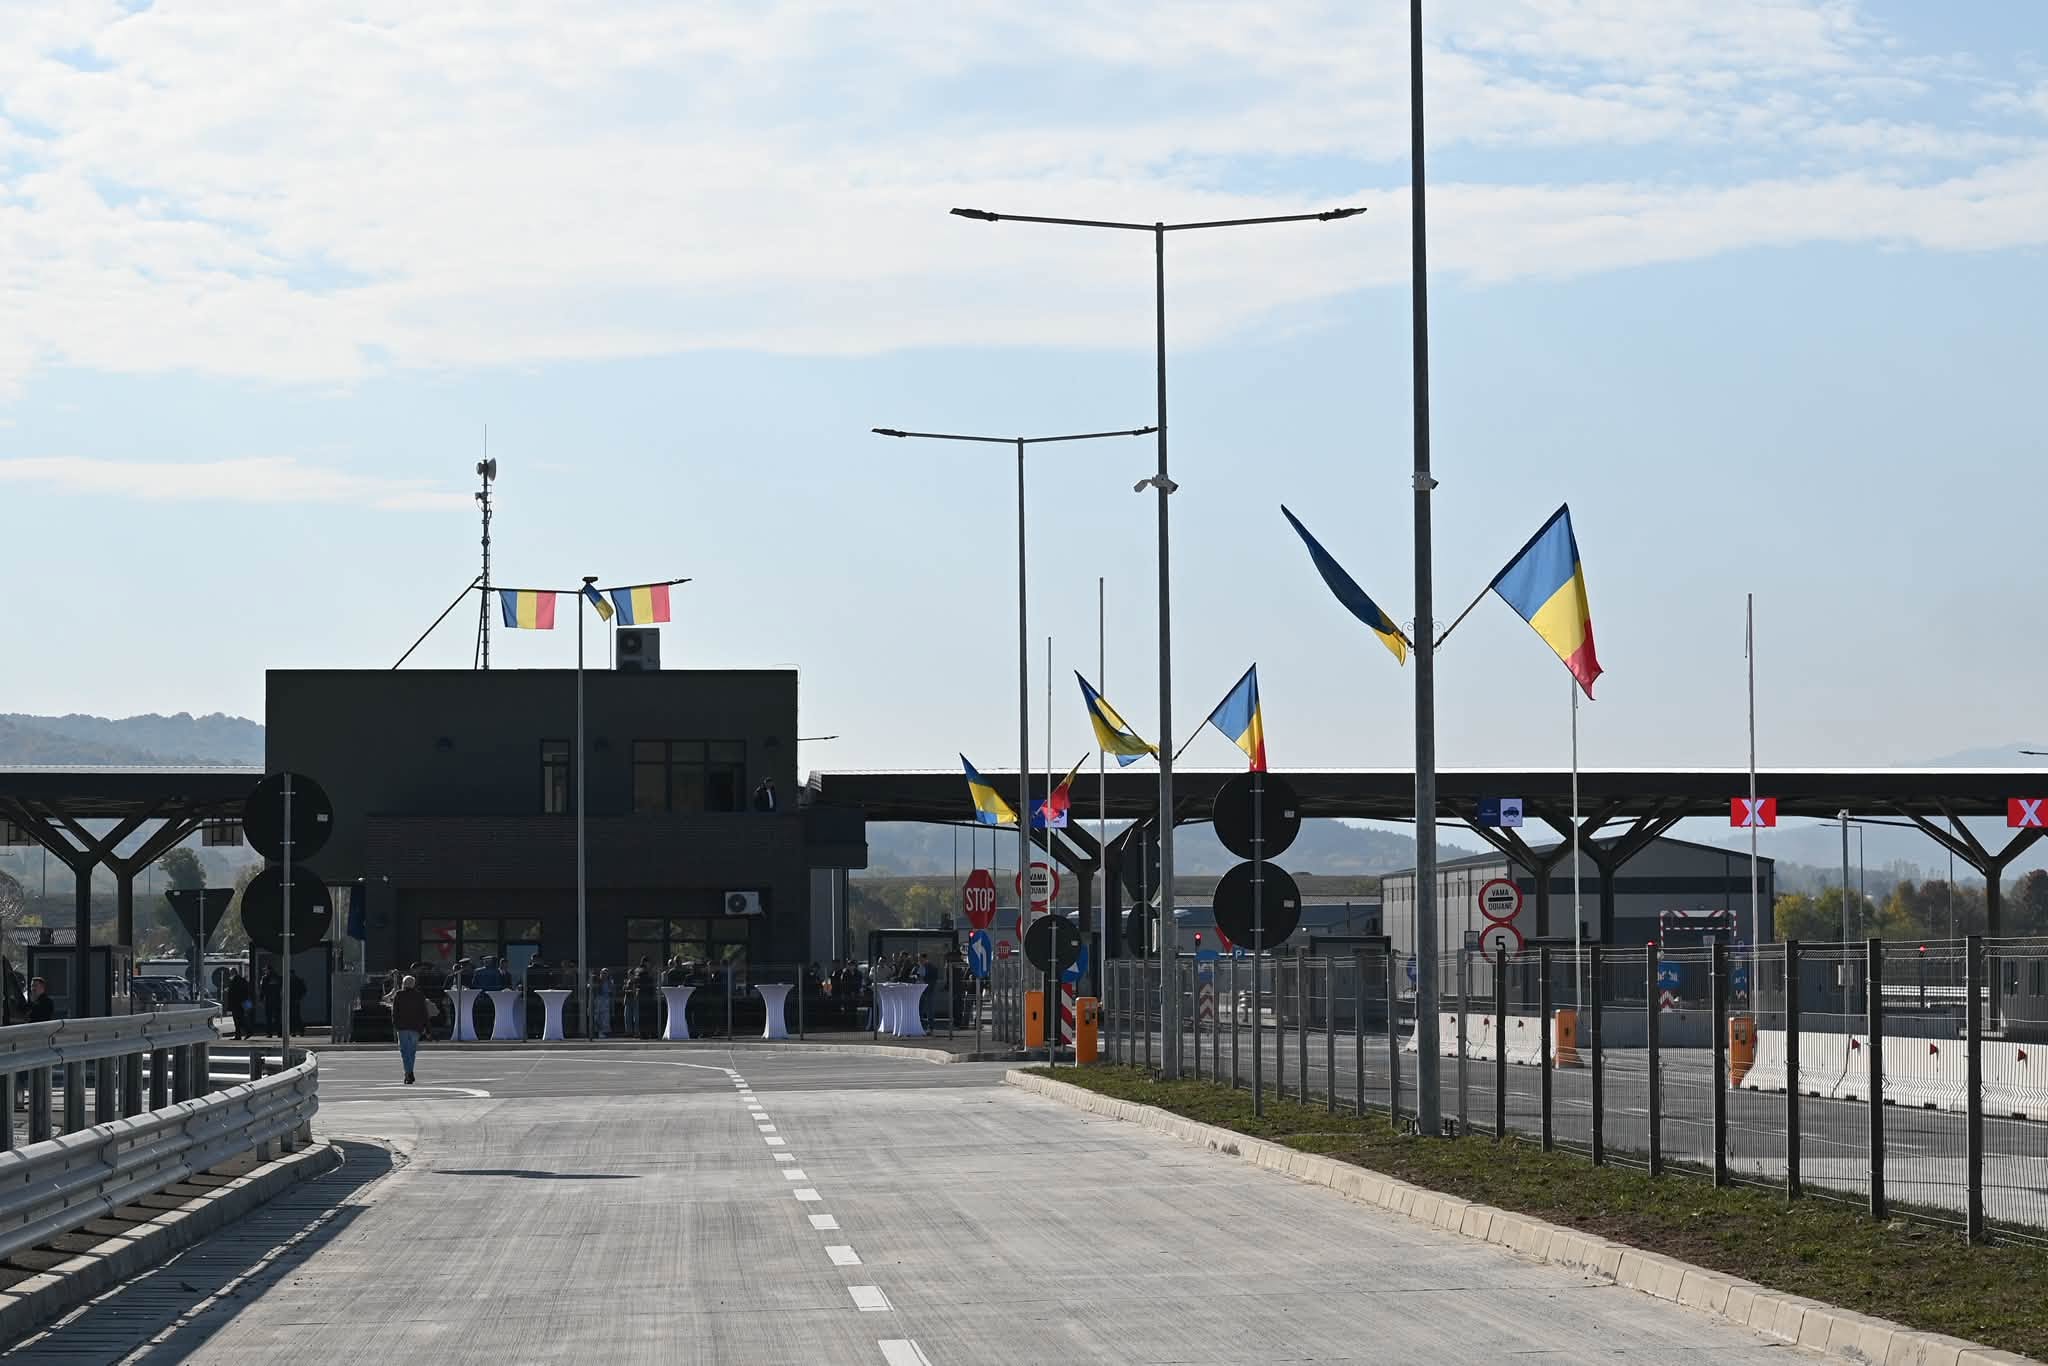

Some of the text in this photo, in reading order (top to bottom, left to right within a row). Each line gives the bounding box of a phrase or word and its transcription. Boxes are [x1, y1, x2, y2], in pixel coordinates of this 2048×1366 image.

[1491, 888, 1509, 897] VAMA
[965, 887, 995, 912] STOP
[1488, 902, 1513, 911] DOUANE
[1495, 935, 1506, 953] 5
